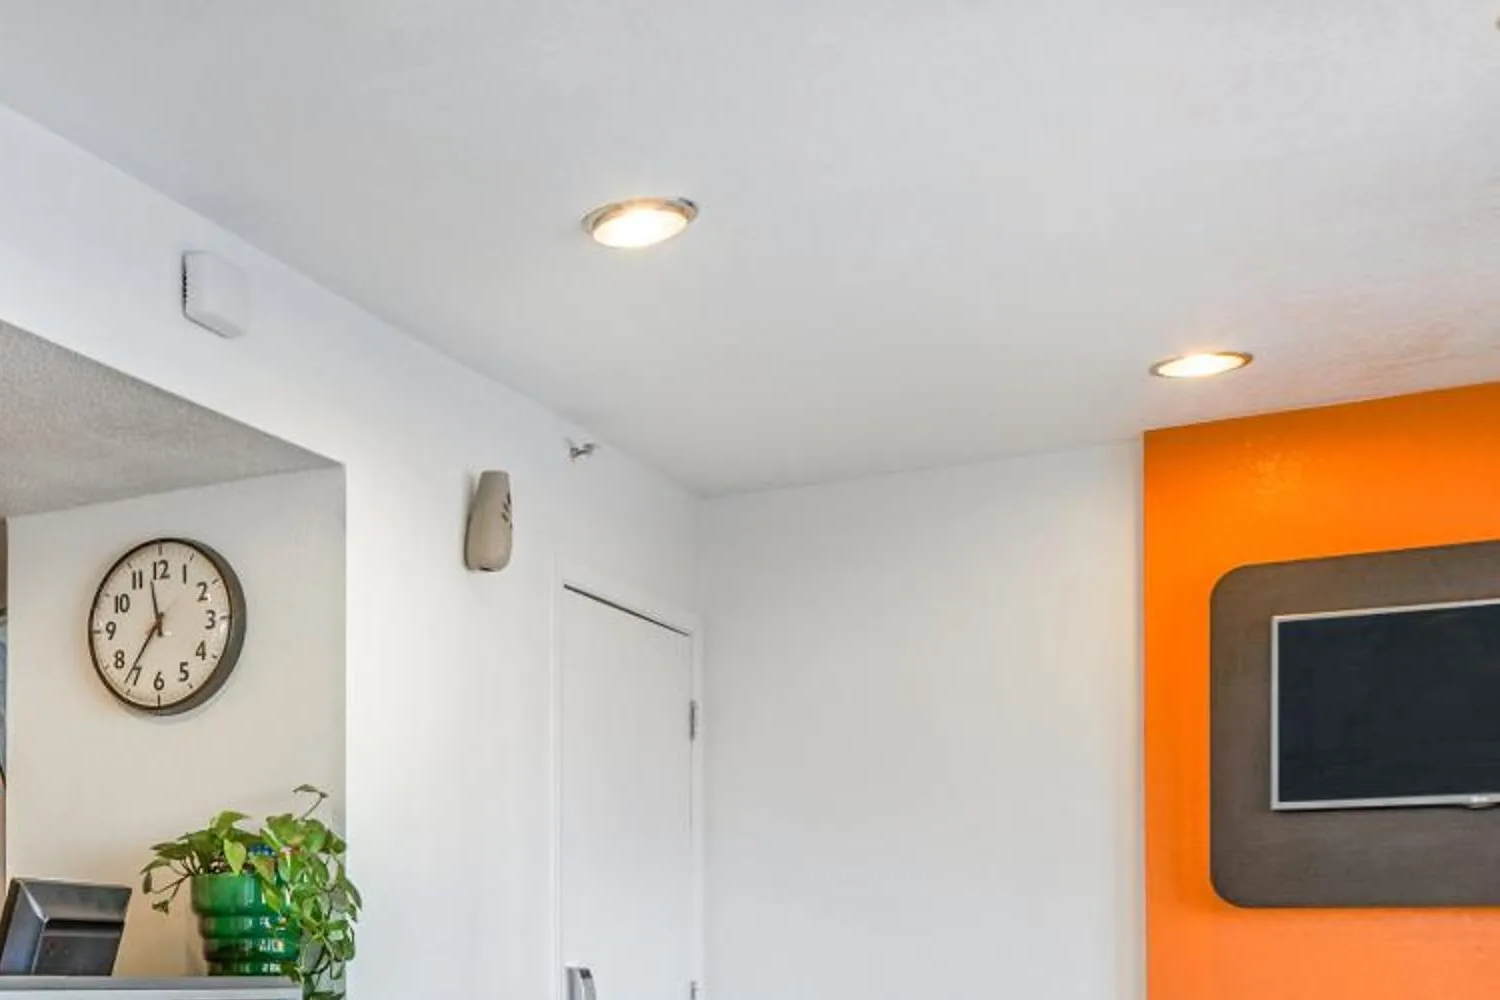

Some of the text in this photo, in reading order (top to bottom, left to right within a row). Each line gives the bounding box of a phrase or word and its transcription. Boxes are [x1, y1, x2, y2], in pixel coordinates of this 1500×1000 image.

[131, 570, 143, 590] 11
[152, 560, 170, 580] 12
[182, 563, 188, 584] 1
[196, 581, 209, 602] 2
[114, 593, 130, 613] 10
[205, 610, 216, 630] 3
[105, 621, 117, 640] 9
[113, 650, 125, 669] 8
[195, 640, 206, 660] 4
[131, 666, 142, 686] 7
[153, 671, 165, 691] 6
[177, 661, 189, 682] 5
